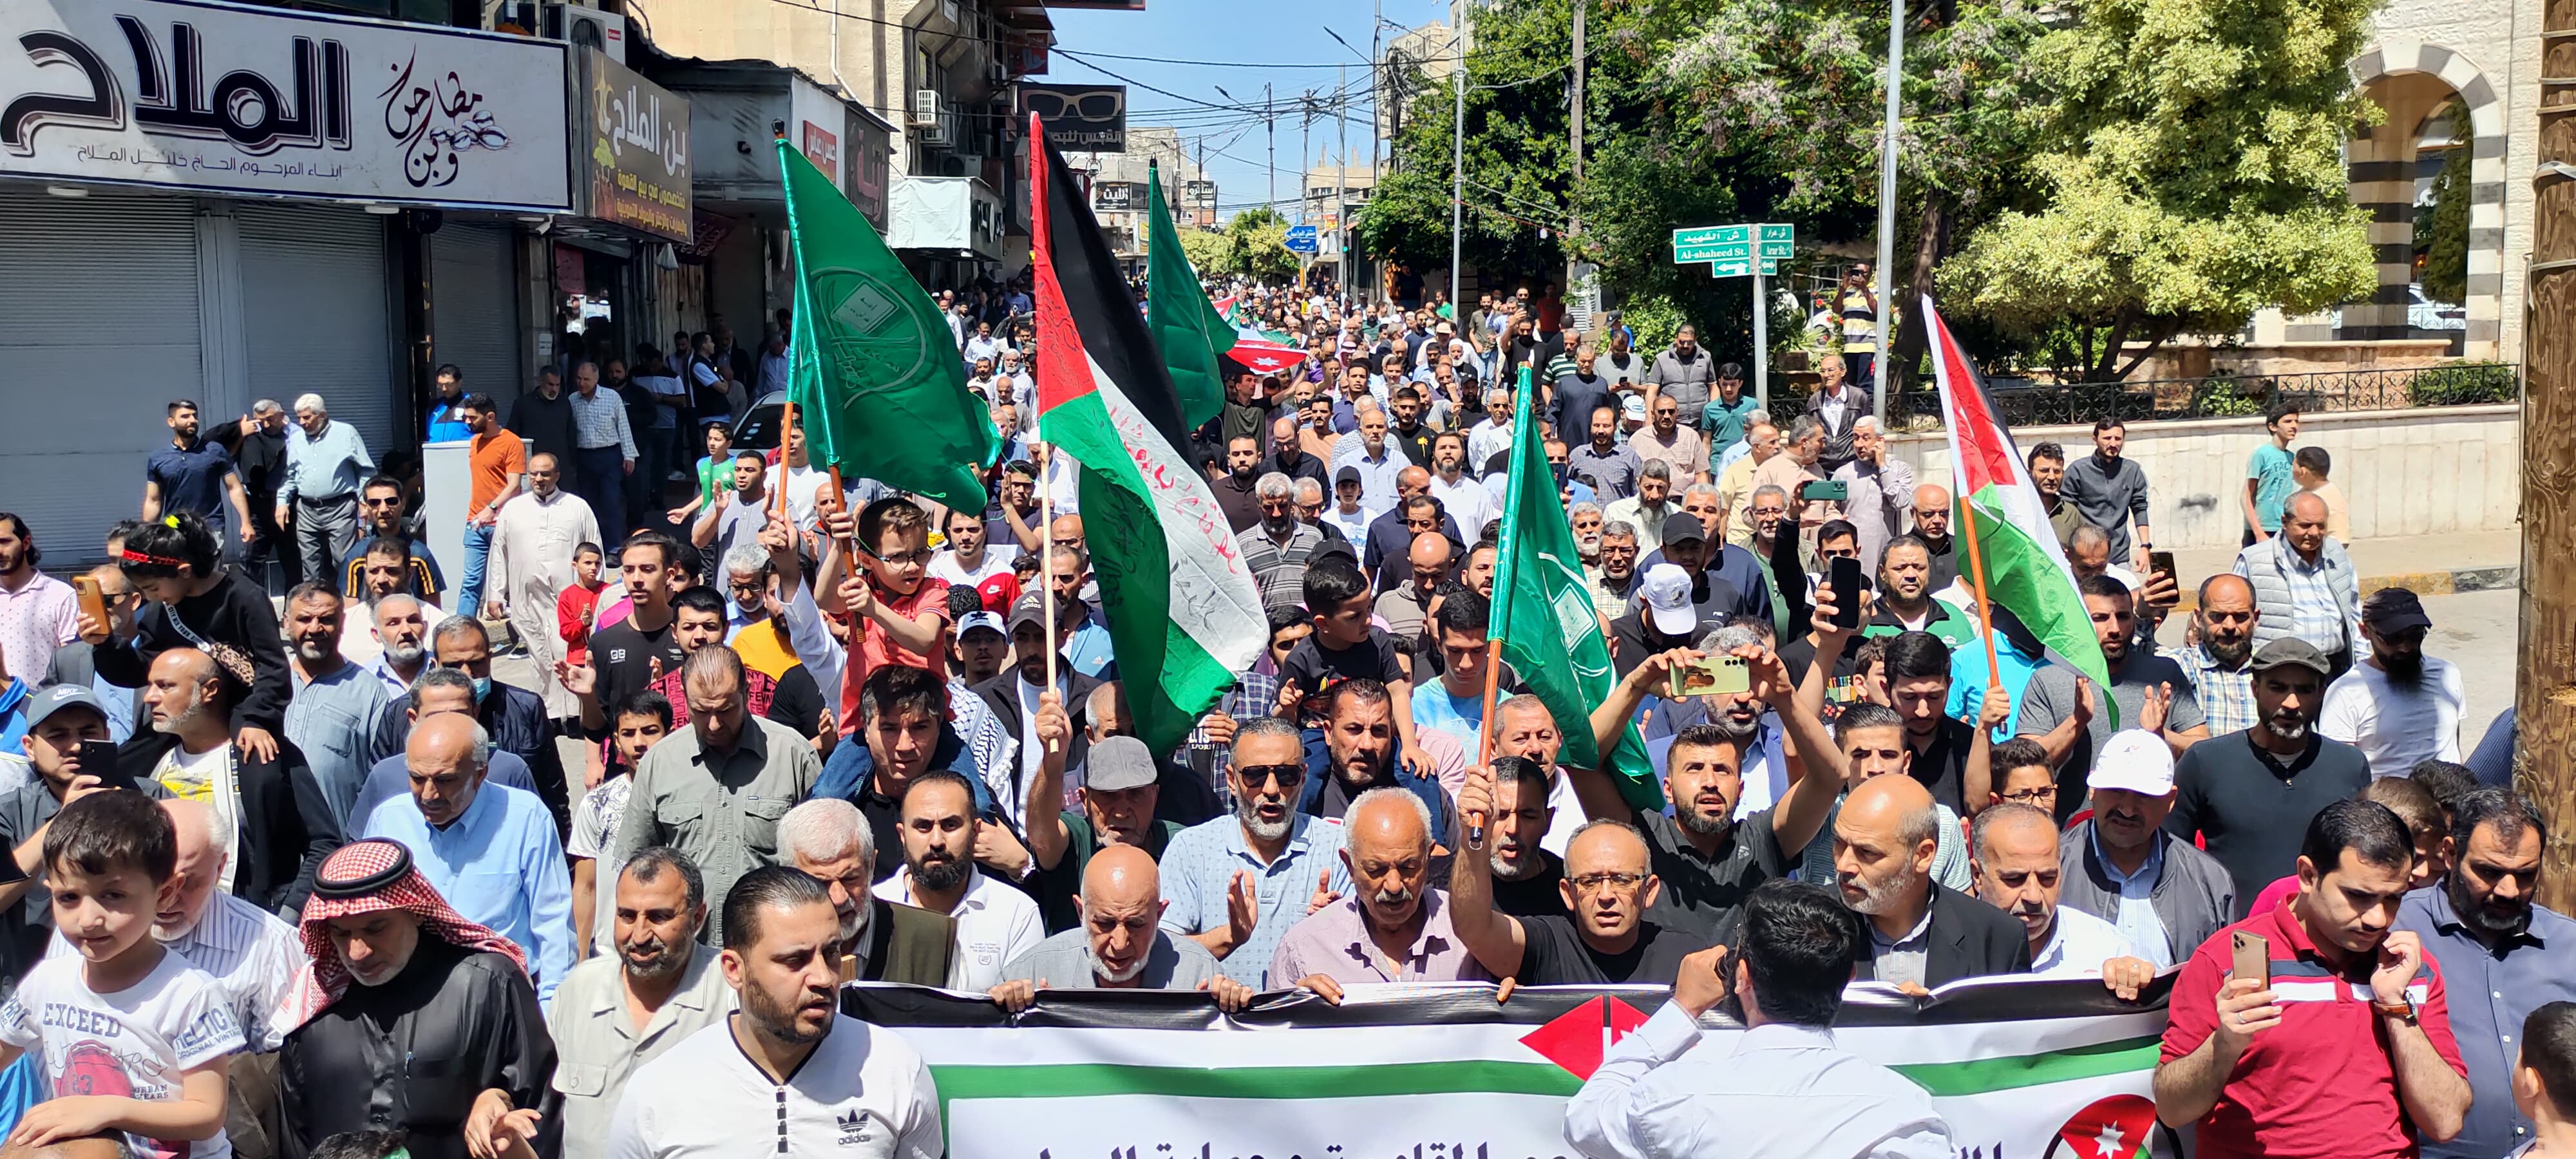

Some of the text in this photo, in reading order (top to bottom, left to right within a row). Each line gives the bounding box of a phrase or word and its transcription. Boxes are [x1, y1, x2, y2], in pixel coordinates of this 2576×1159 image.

[0, 14, 352, 158] الملاح
[613, 85, 686, 178] بن الملاح
[77, 145, 126, 162] الملاح
[131, 148, 187, 167] خليل
[192, 154, 236, 173] الحاج
[240, 161, 303, 177] المرحوم
[1684, 232, 1720, 243] الشهيد
[1681, 247, 1747, 259] Al-shaheed St.
[43, 1003, 121, 1039] EXCEED
[838, 1133, 871, 1145] adidas
